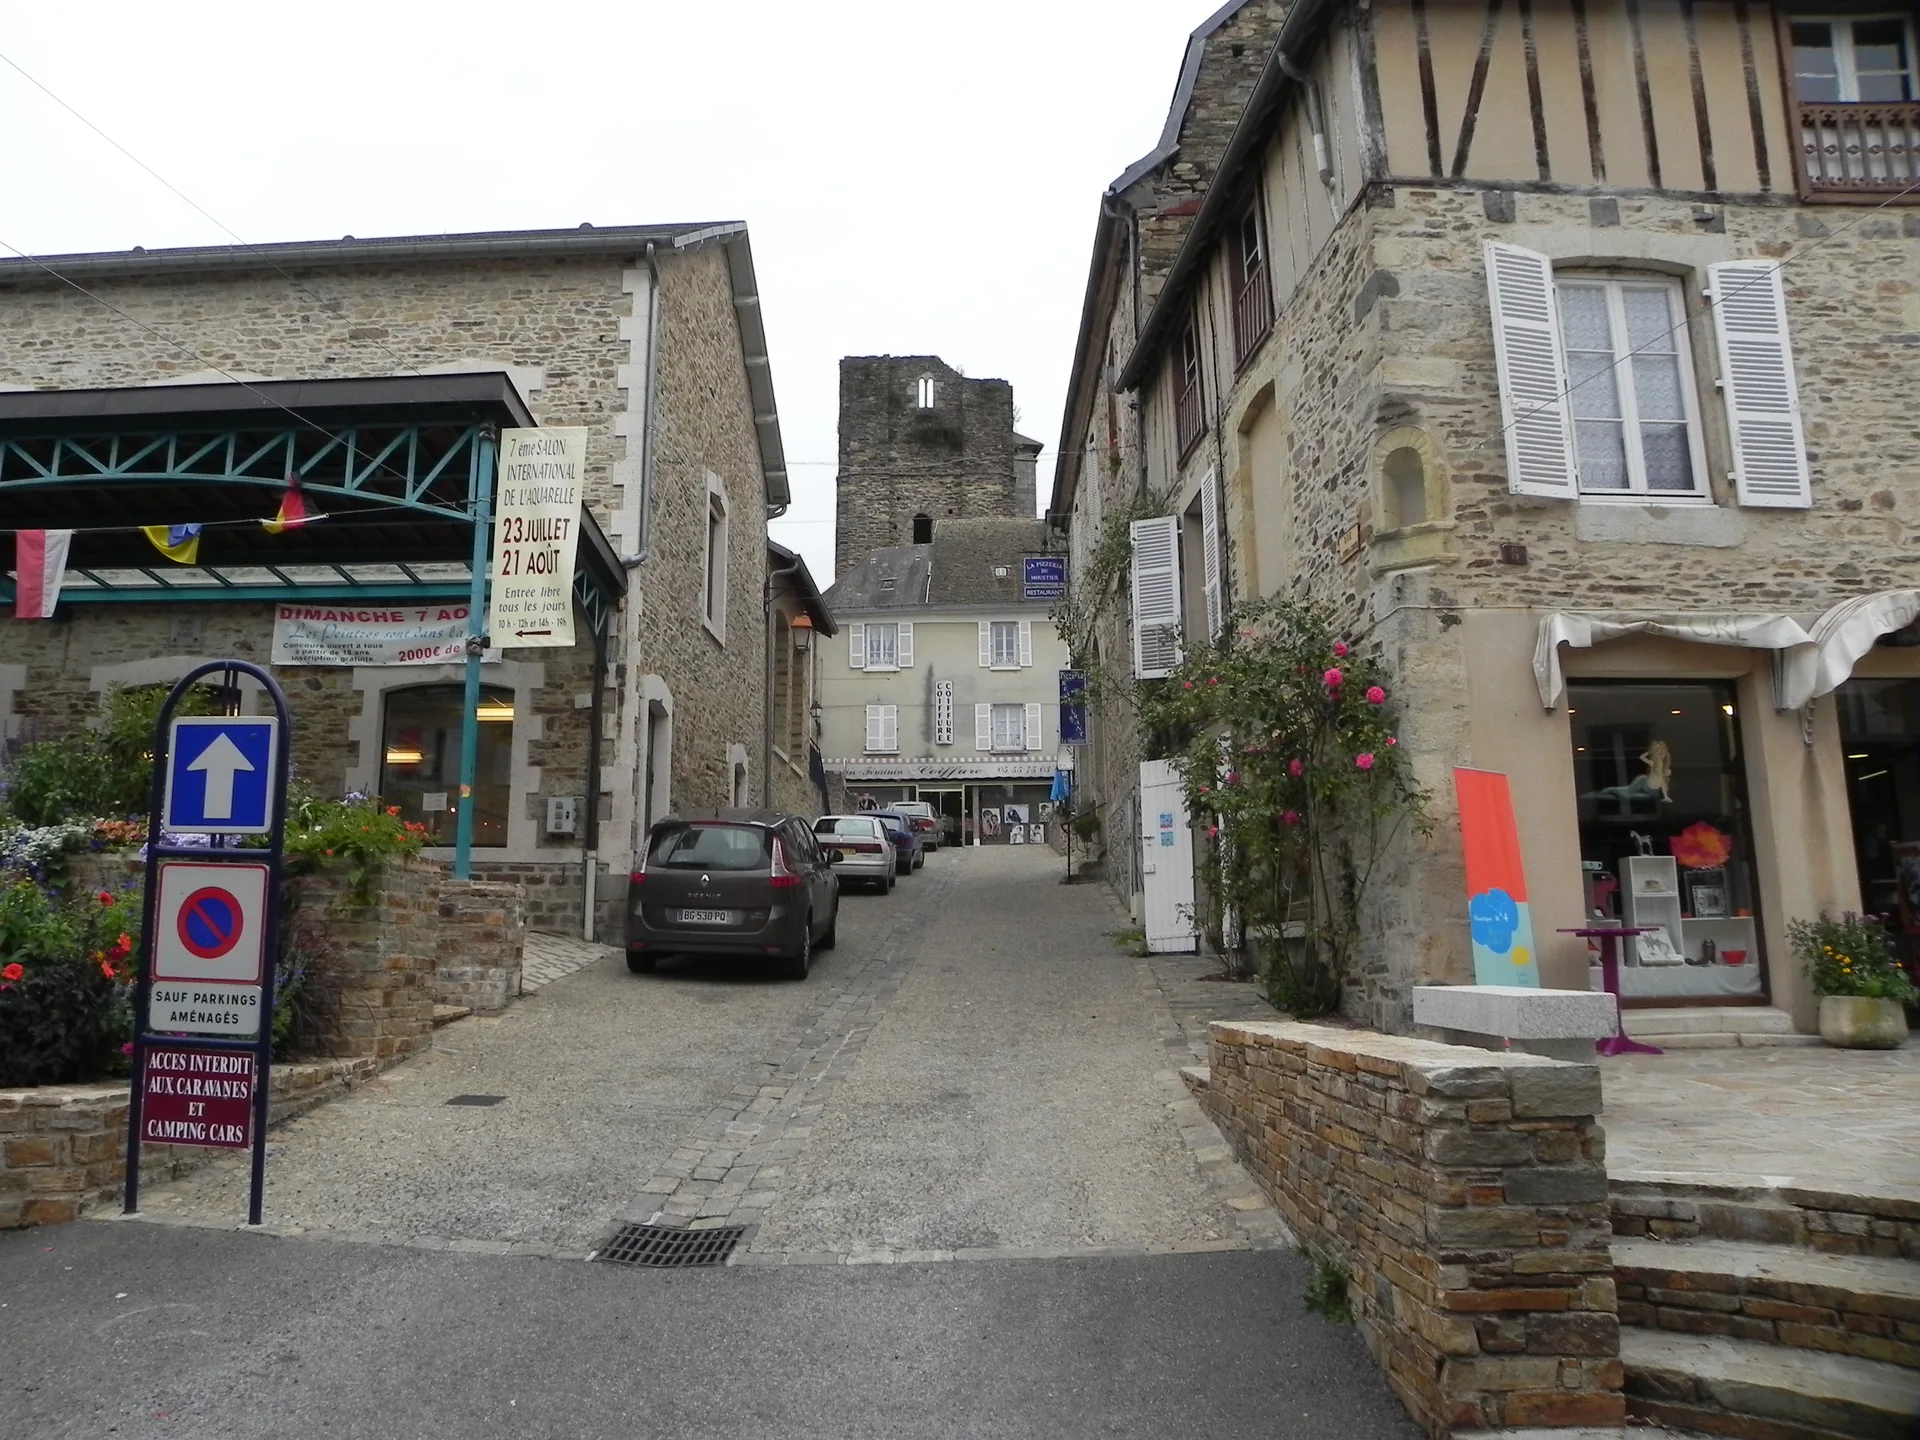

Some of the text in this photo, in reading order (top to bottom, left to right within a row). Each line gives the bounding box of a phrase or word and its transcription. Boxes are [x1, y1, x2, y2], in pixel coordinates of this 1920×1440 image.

[510, 438, 566, 457] 7 ème SALON
[507, 463, 576, 481] INTERNATIONAL
[504, 486, 575, 506] DE L'AQUARELLE
[503, 517, 570, 543] 23 JUILLET
[502, 542, 560, 575] 21 AOÛT
[1036, 561, 1063, 570] PIZZERIA
[505, 586, 561, 599] Entrée libre
[280, 607, 470, 623] DIMANCHE 7 AO
[498, 601, 566, 614] tous les jours
[518, 618, 529, 628] 12h
[530, 619, 537, 628] et
[321, 623, 379, 643] Peintres
[384, 630, 410, 639] sont
[414, 626, 443, 638] dans
[449, 625, 464, 638] la
[302, 648, 326, 656] partir
[399, 645, 460, 662] 2000€ de
[917, 765, 982, 778] Coiffure
[155, 991, 257, 1006] SAUF PARKINGS
[170, 1009, 239, 1025] AMÉNAGÉS
[149, 1052, 251, 1075] ACCES INTERDIT
[148, 1076, 249, 1099] AUX CARAVANES
[188, 1101, 205, 1117] ET
[147, 1119, 244, 1143] CAMPING CARS
